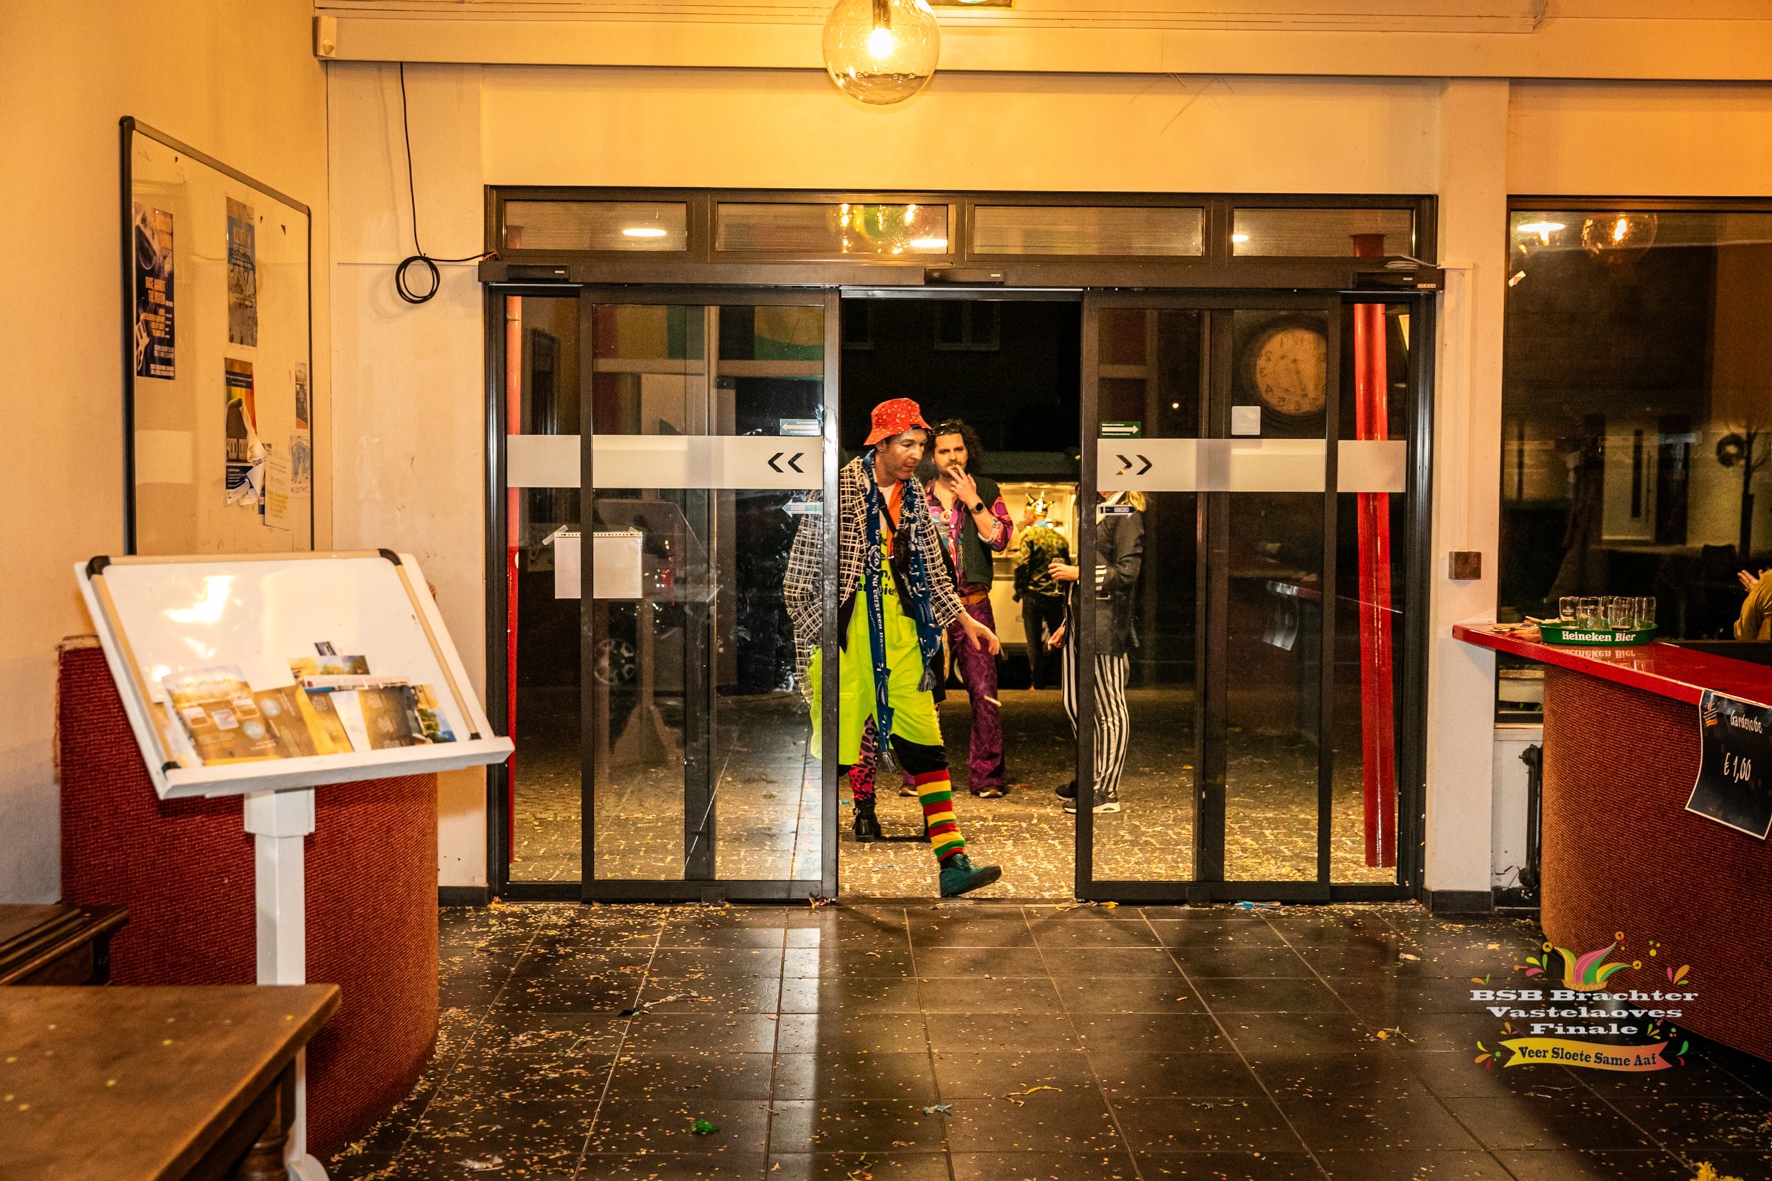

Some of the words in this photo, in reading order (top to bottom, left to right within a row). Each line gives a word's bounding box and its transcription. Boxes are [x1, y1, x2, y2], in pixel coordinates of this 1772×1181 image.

[1562, 631, 1612, 642] Heineken
[1615, 632, 1636, 642] Bier
[1733, 756, 1752, 784] 1,00
